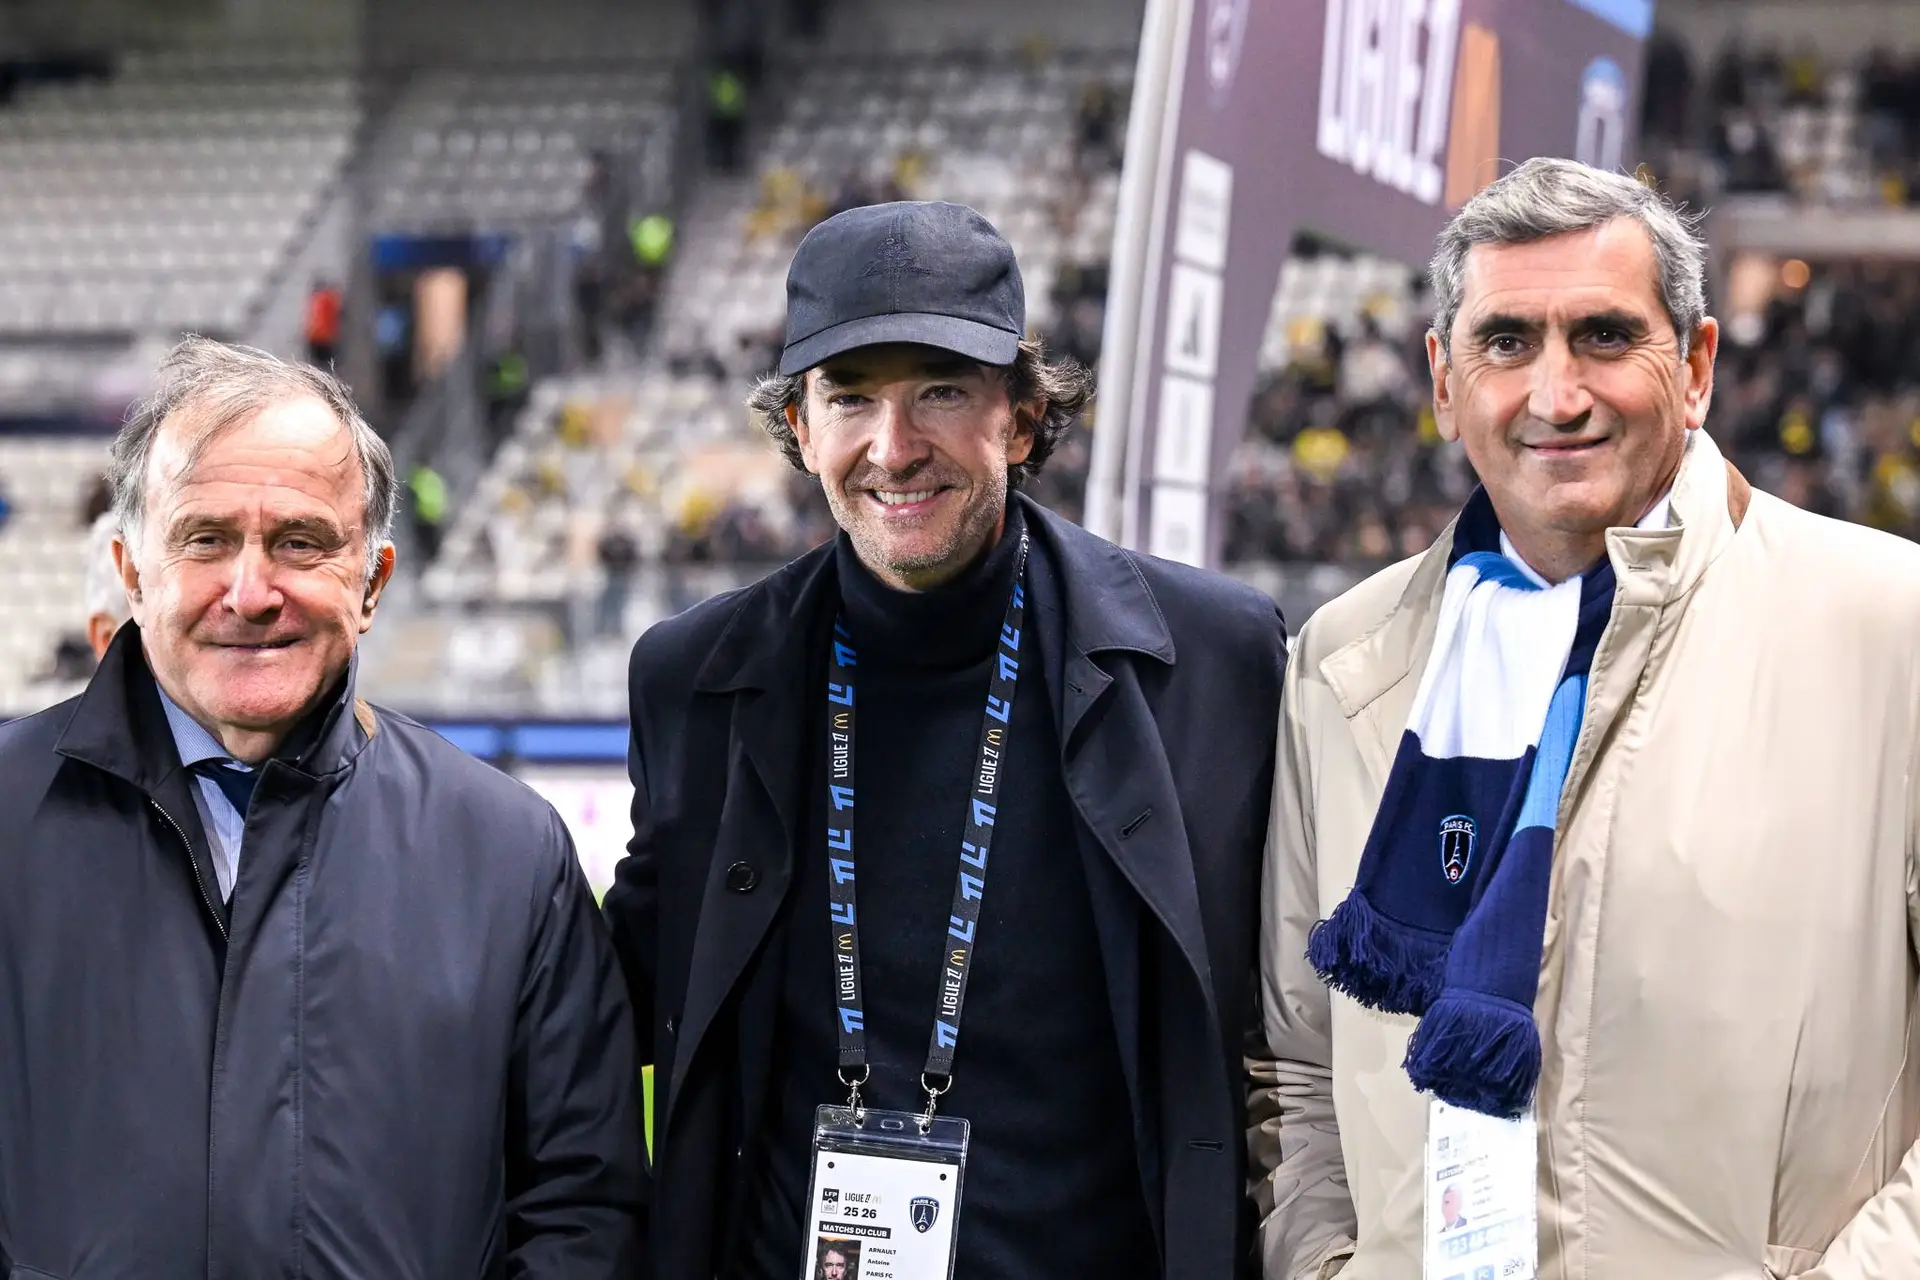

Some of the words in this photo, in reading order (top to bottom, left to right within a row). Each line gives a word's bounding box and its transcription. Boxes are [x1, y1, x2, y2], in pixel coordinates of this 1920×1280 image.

[834, 743, 849, 778] LIGUE
[977, 758, 998, 795] LIGUE
[1444, 820, 1463, 830] PARIS
[1464, 822, 1473, 831] FC
[840, 964, 856, 1001] LIGUE
[941, 979, 961, 1016] LIGUE
[824, 1190, 838, 1198] LFP
[844, 1192, 864, 1203] LIGUE
[843, 1206, 859, 1217] 25
[861, 1208, 877, 1219] 26
[822, 1224, 855, 1234] MATCHS
[855, 1227, 867, 1235] DU
[867, 1228, 888, 1237] CLUB
[868, 1247, 897, 1256] ARNAULT
[867, 1258, 890, 1266] Antoine
